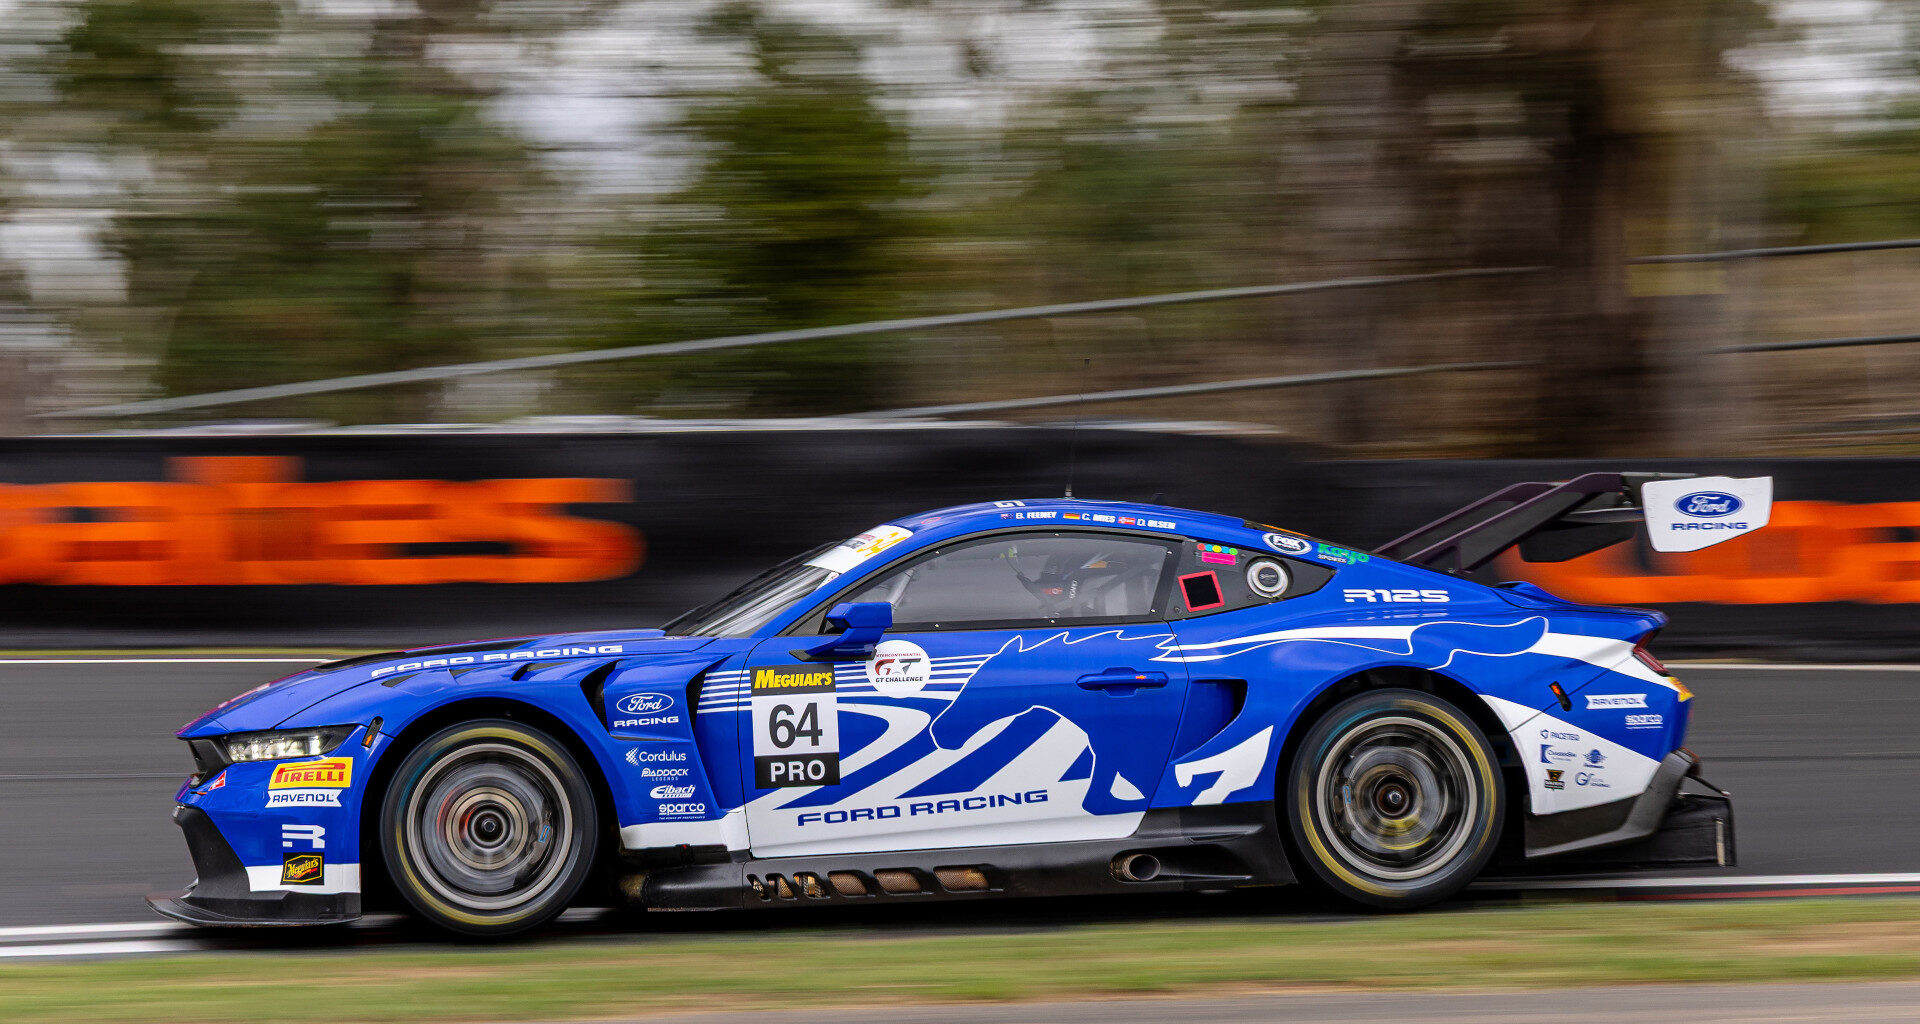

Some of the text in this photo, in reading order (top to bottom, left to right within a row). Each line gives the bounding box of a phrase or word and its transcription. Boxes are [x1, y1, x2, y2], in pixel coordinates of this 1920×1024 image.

[1687, 495, 1731, 513] Ford
[1026, 511, 1057, 519] FEENEY
[1671, 522, 1748, 531] RACING
[1342, 588, 1451, 603] R125
[371, 645, 623, 678] FORD RACING
[627, 695, 662, 711] Ford
[1591, 697, 1642, 706] RAVENOL
[613, 716, 680, 728] RACING
[768, 702, 823, 749] 64
[639, 750, 687, 762] Cordulus
[274, 762, 347, 784] PIRELLI
[769, 759, 826, 783] PRO
[272, 793, 335, 803] RAVENOL
[649, 784, 697, 799] Eibach
[658, 802, 706, 816] sparco
[797, 789, 1049, 827] FORD RACING
